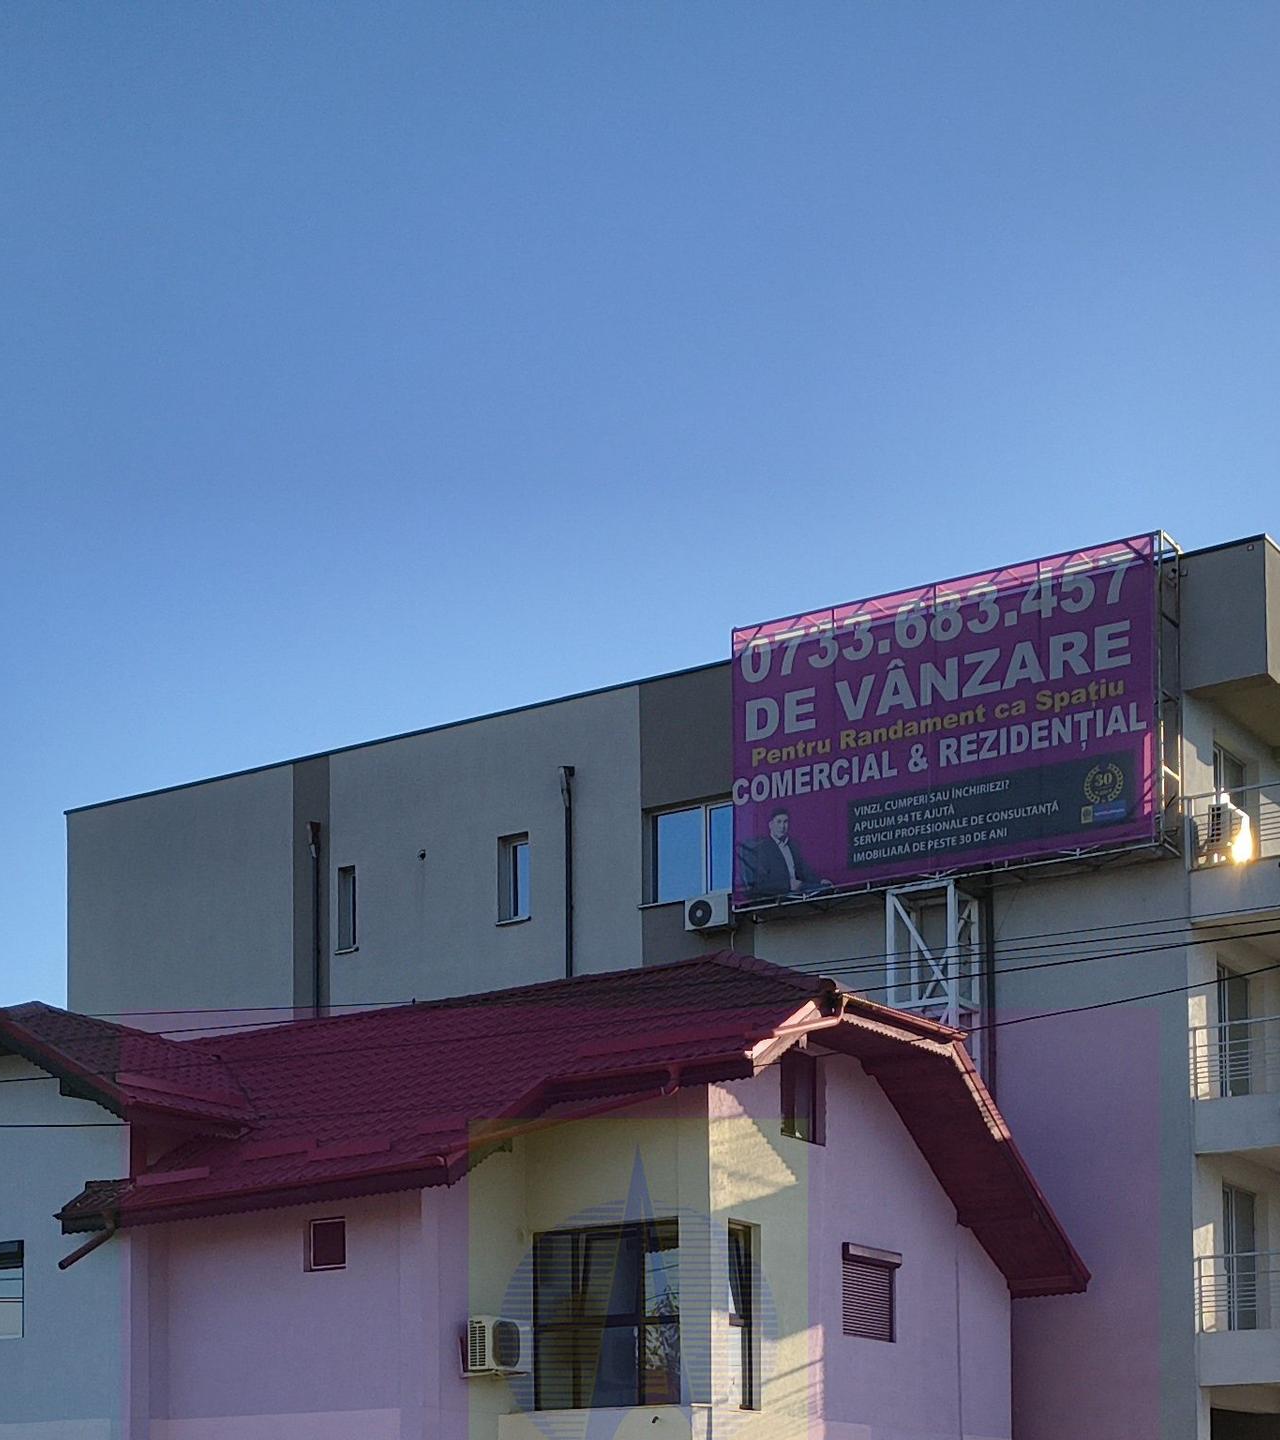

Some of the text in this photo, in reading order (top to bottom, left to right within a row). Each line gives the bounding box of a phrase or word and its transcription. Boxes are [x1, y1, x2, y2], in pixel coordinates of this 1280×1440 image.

[740, 549, 1135, 683] 0733.683.457
[745, 620, 1131, 742] DE VÂNZARE
[752, 678, 1125, 768] Pentru Randament ca Spațiu
[732, 702, 1147, 806] COMERCIAL & REZIDENȚIAL
[1094, 772, 1113, 787] 30
[885, 794, 928, 811] CUMPERI
[929, 789, 950, 804] SAU
[853, 830, 893, 847] SERVICII
[895, 818, 969, 840] PROFESIONALE
[971, 814, 984, 825] DE
[854, 817, 895, 832] APULUM
[897, 813, 909, 824] 94
[910, 811, 922, 822] TE
[913, 840, 926, 852] DE
[928, 836, 957, 849] PESTE
[959, 833, 971, 845] 30
[974, 831, 987, 842] DE
[989, 827, 1007, 840] ANI
